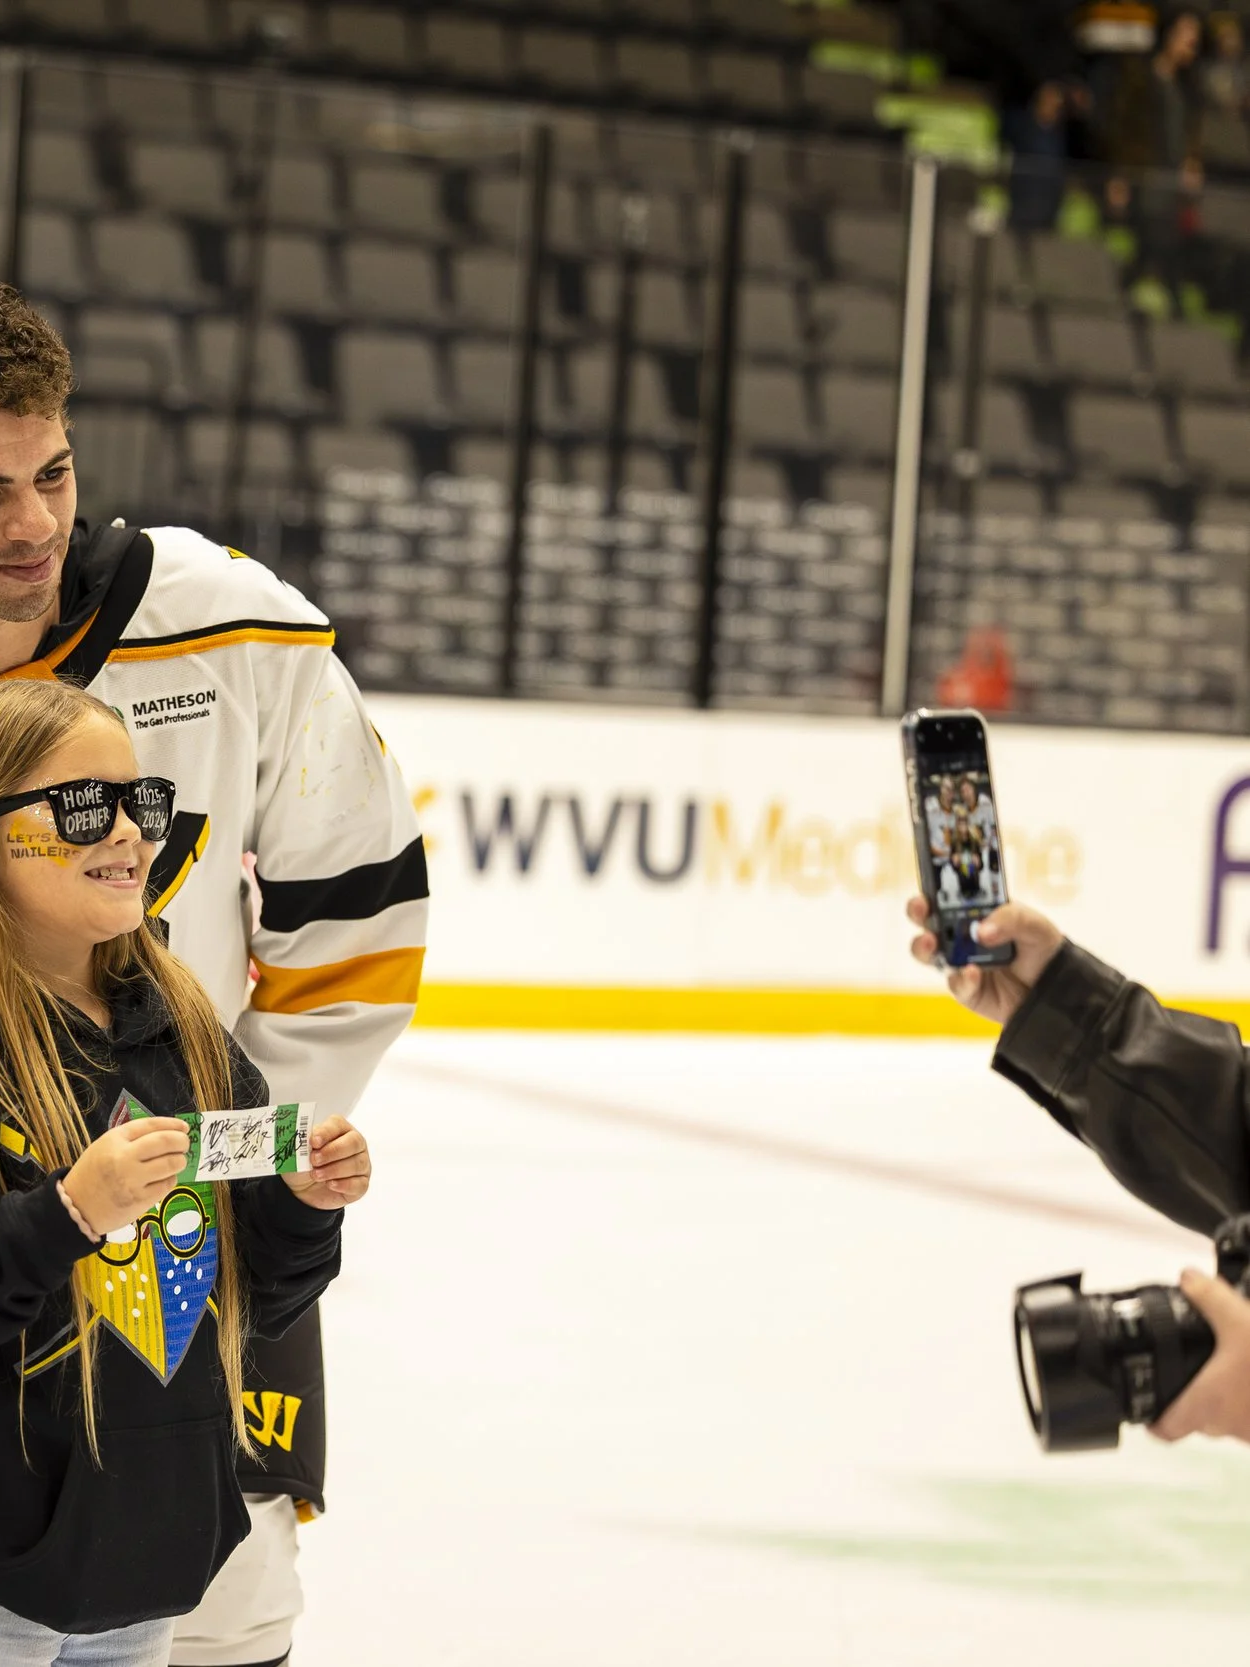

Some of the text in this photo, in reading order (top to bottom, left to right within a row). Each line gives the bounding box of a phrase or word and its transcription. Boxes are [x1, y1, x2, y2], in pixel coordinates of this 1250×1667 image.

[132, 689, 217, 717] MATHESON
[135, 708, 210, 730] The Gas Professionals
[62, 787, 104, 811] HOME
[65, 806, 111, 834] OPENER
[6, 832, 52, 843] LET'S
